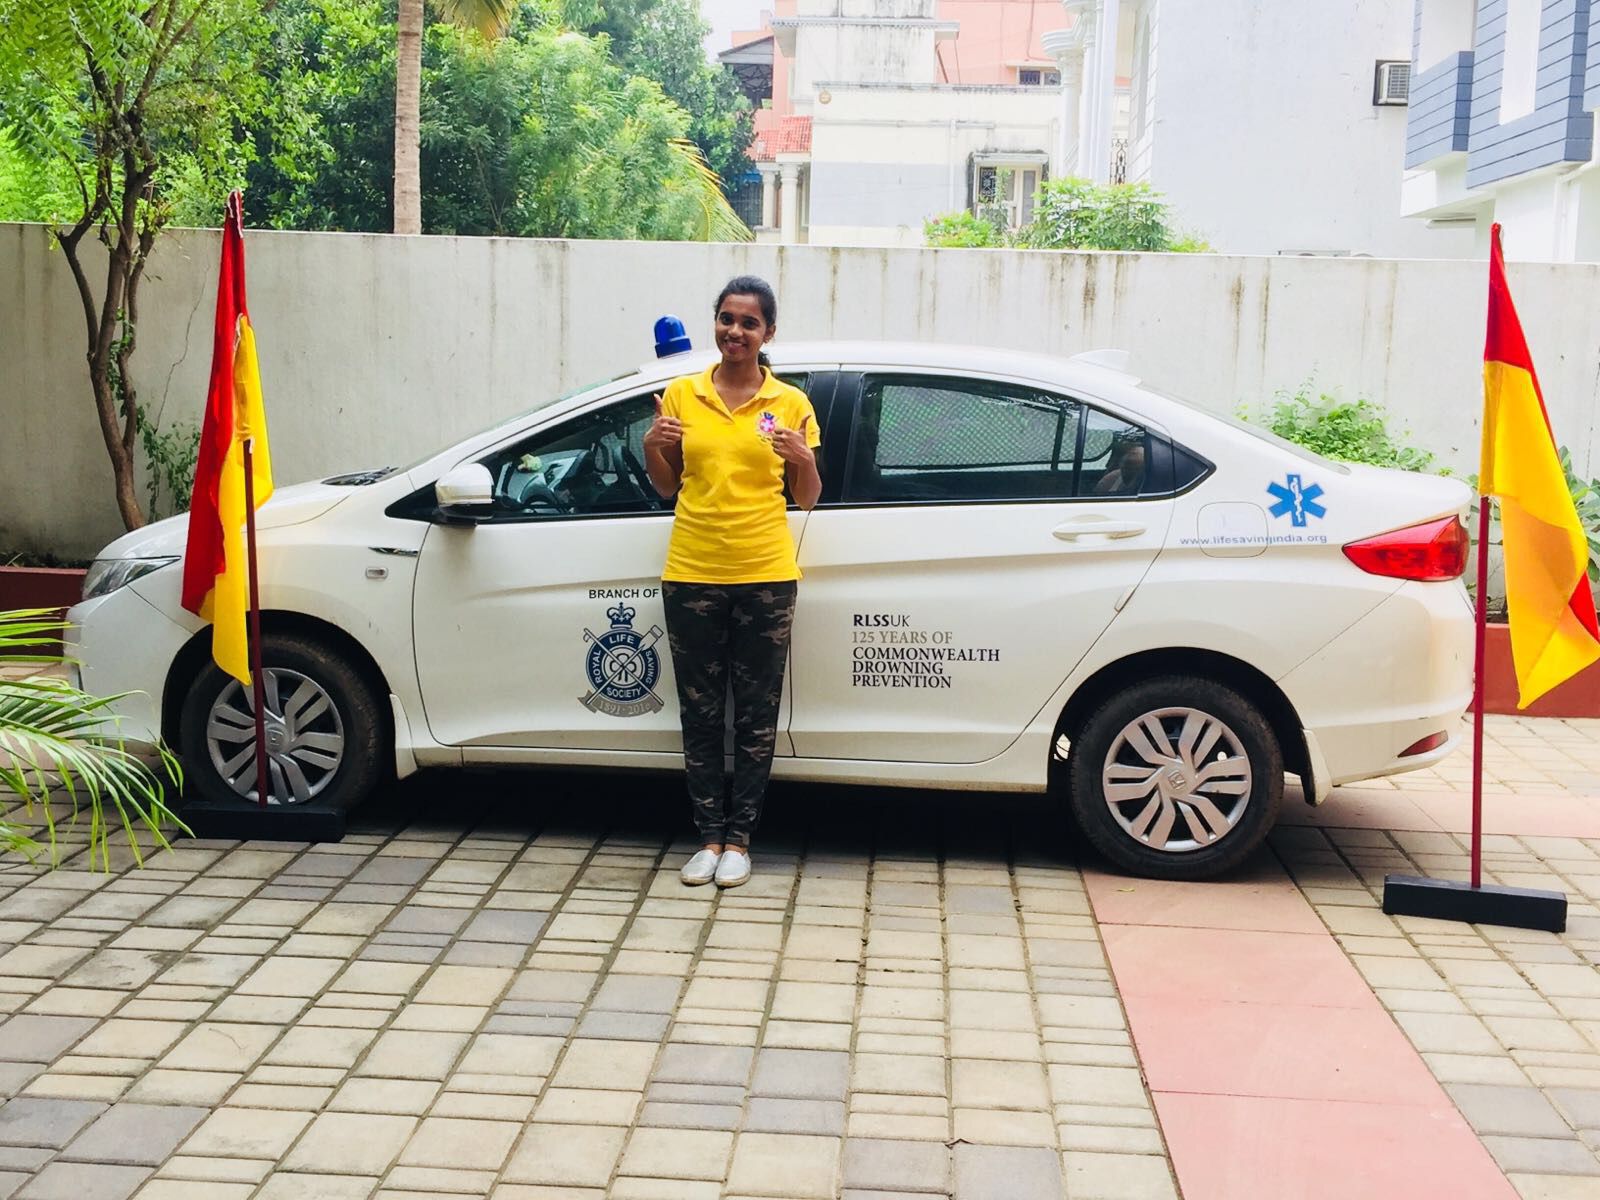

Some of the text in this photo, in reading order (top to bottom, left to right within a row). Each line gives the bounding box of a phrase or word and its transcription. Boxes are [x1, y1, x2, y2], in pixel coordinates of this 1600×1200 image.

[1180, 534, 1328, 545] www.lifesavingindia.org
[588, 588, 659, 598] BRANCH OF
[853, 614, 910, 627] RLSSUK
[609, 634, 634, 644] LIFE
[851, 630, 953, 644] 125 YEARS OF
[852, 647, 1001, 662] COMMONWEALTH
[592, 649, 603, 684] ROYAL
[645, 650, 655, 684] SAVING
[852, 661, 944, 675] DROWNING
[852, 674, 952, 689] PREVENTION
[606, 687, 642, 698] SOCIETY
